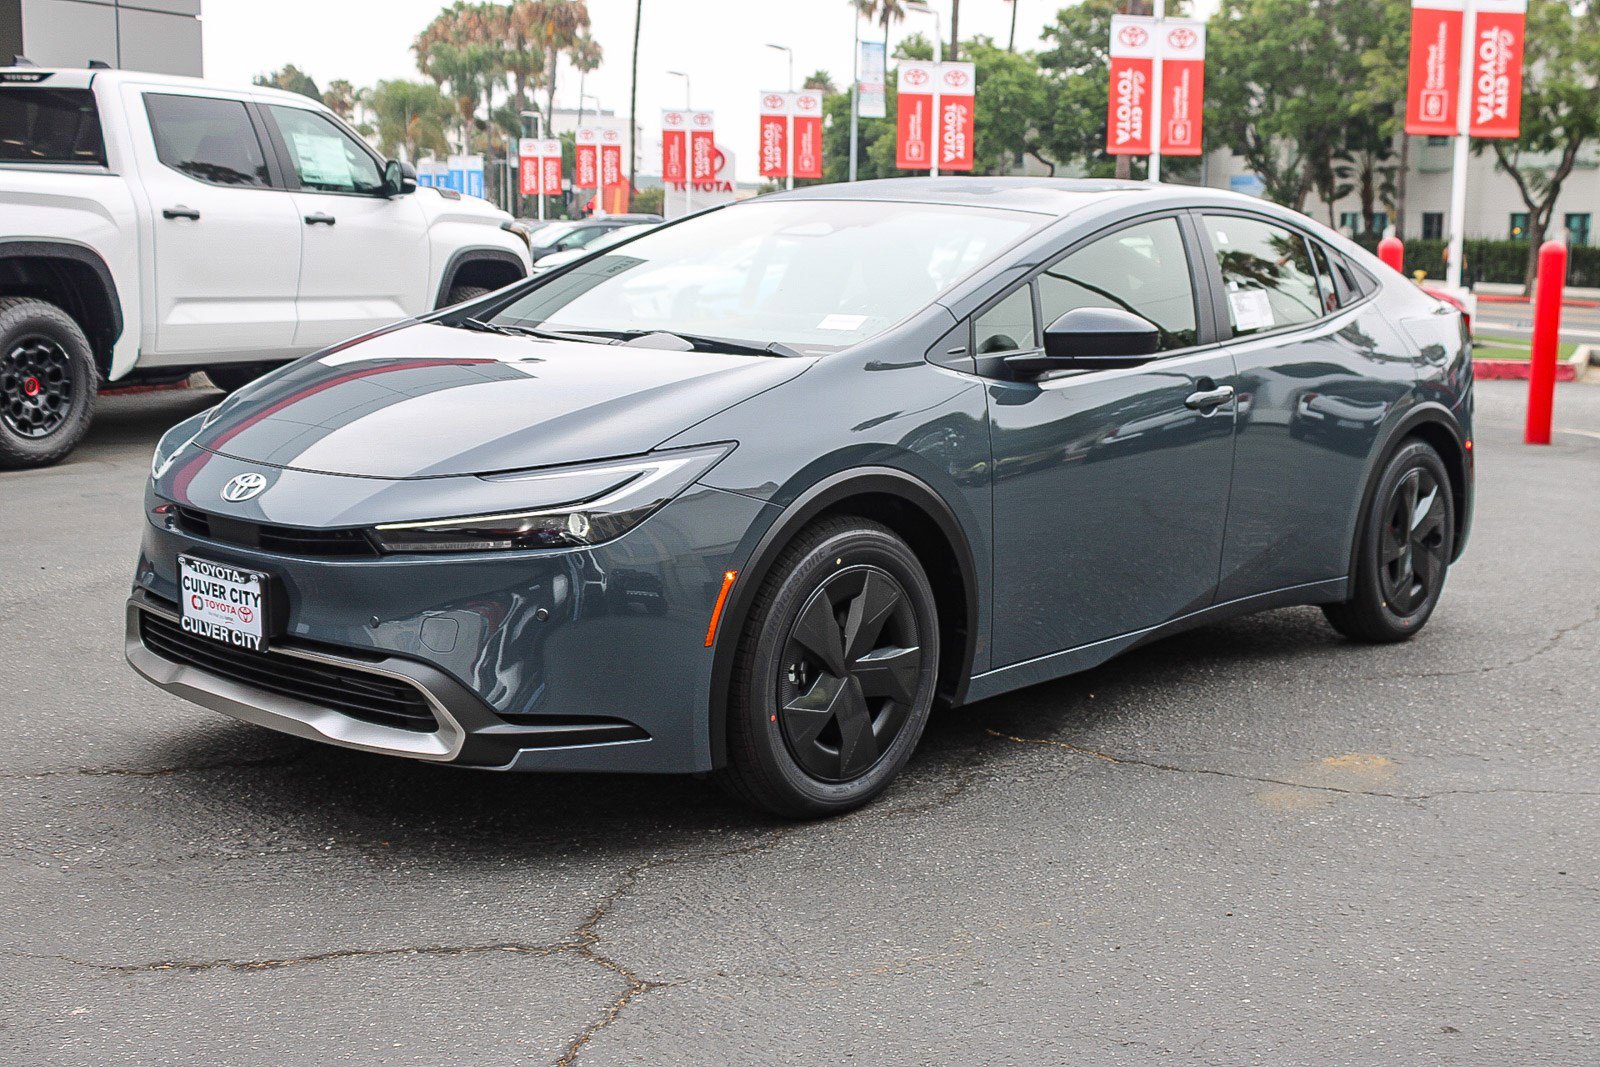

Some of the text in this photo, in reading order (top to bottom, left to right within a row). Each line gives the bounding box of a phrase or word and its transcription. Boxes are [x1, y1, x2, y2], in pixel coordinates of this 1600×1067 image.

[1476, 26, 1499, 125] TOYOTA
[1115, 67, 1133, 145] TOYOTA
[1494, 75, 1510, 119] CITY
[943, 103, 957, 163] TOYOTA
[1131, 106, 1143, 141] CITY
[763, 122, 775, 171] TOYOTA
[955, 132, 965, 160] CITY
[193, 561, 241, 583] TOYOTA
[182, 575, 261, 608] CULVER CITY
[204, 598, 237, 616] TOYOTA
[181, 616, 230, 643] CULVER
[232, 629, 262, 651] CITY
